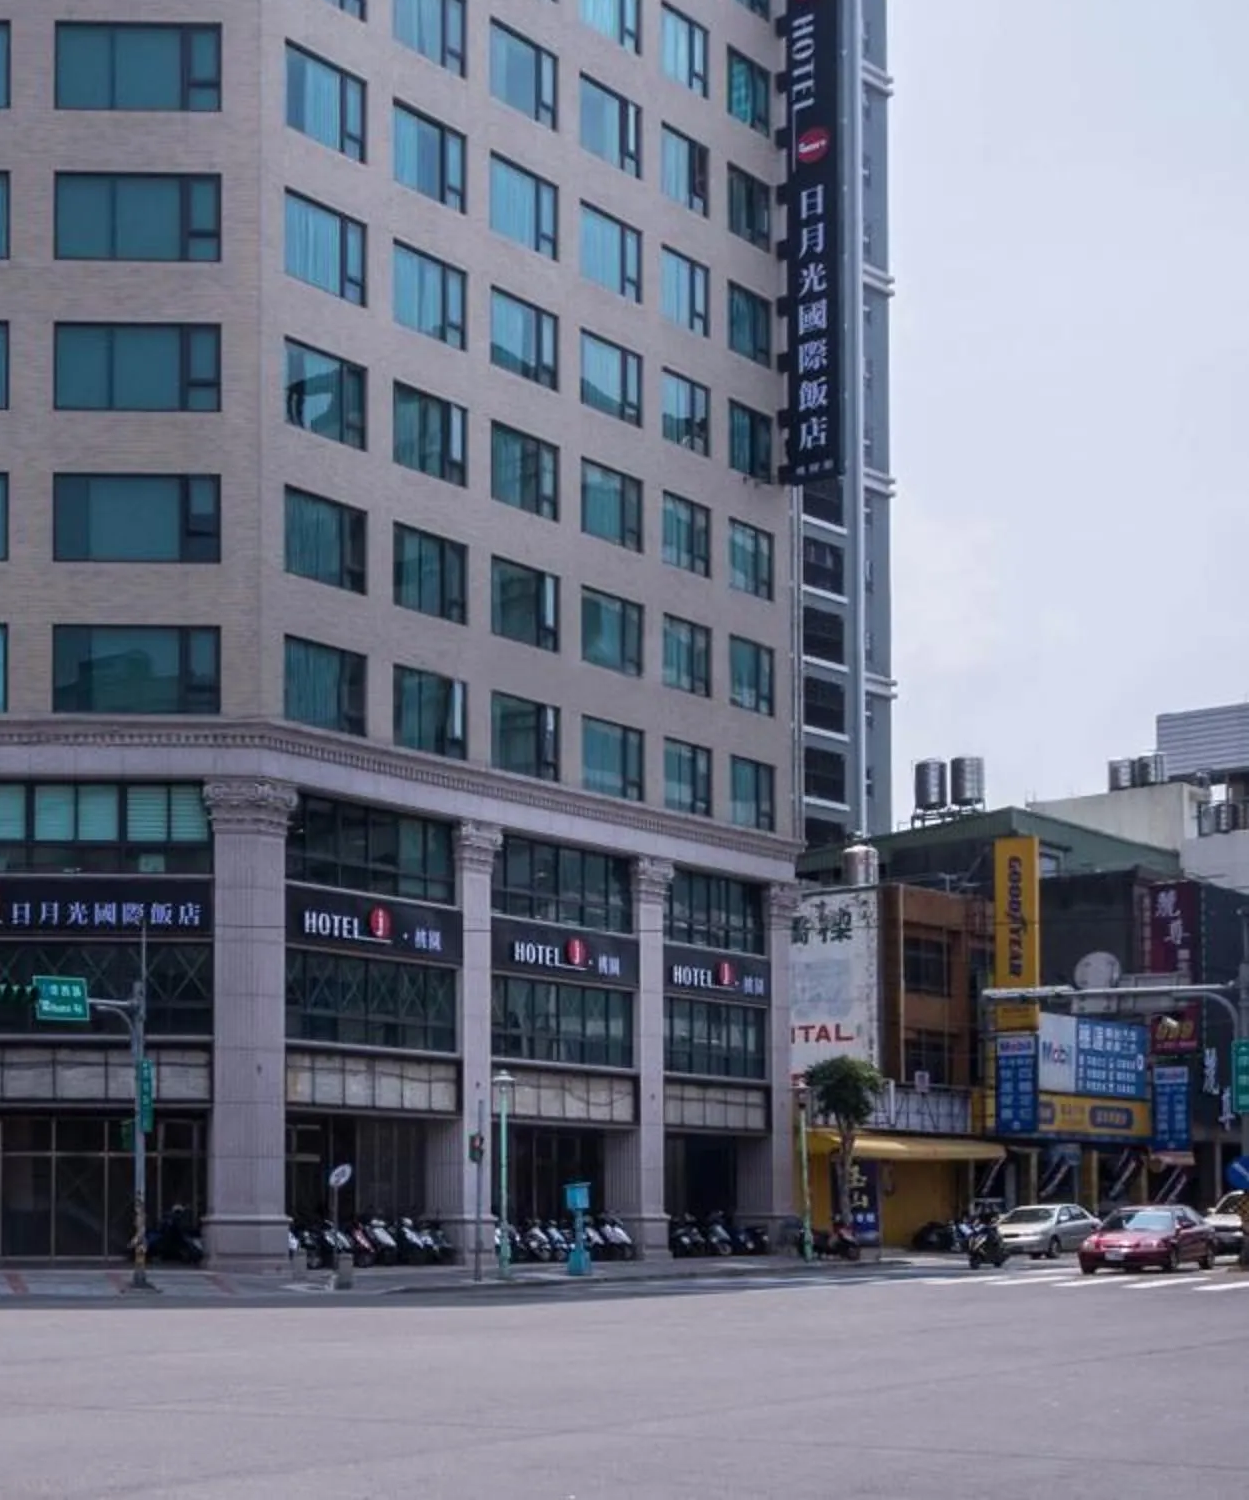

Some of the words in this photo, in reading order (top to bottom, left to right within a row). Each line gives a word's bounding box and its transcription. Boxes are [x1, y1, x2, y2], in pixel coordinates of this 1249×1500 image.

[792, 13, 815, 111] HOTEL
[799, 184, 829, 452] 日月光國際飯店
[11, 902, 201, 926] 日月光國際飯店
[304, 910, 359, 939] HOTEL
[514, 941, 560, 967] HOTEL
[673, 964, 712, 988] HOTEL
